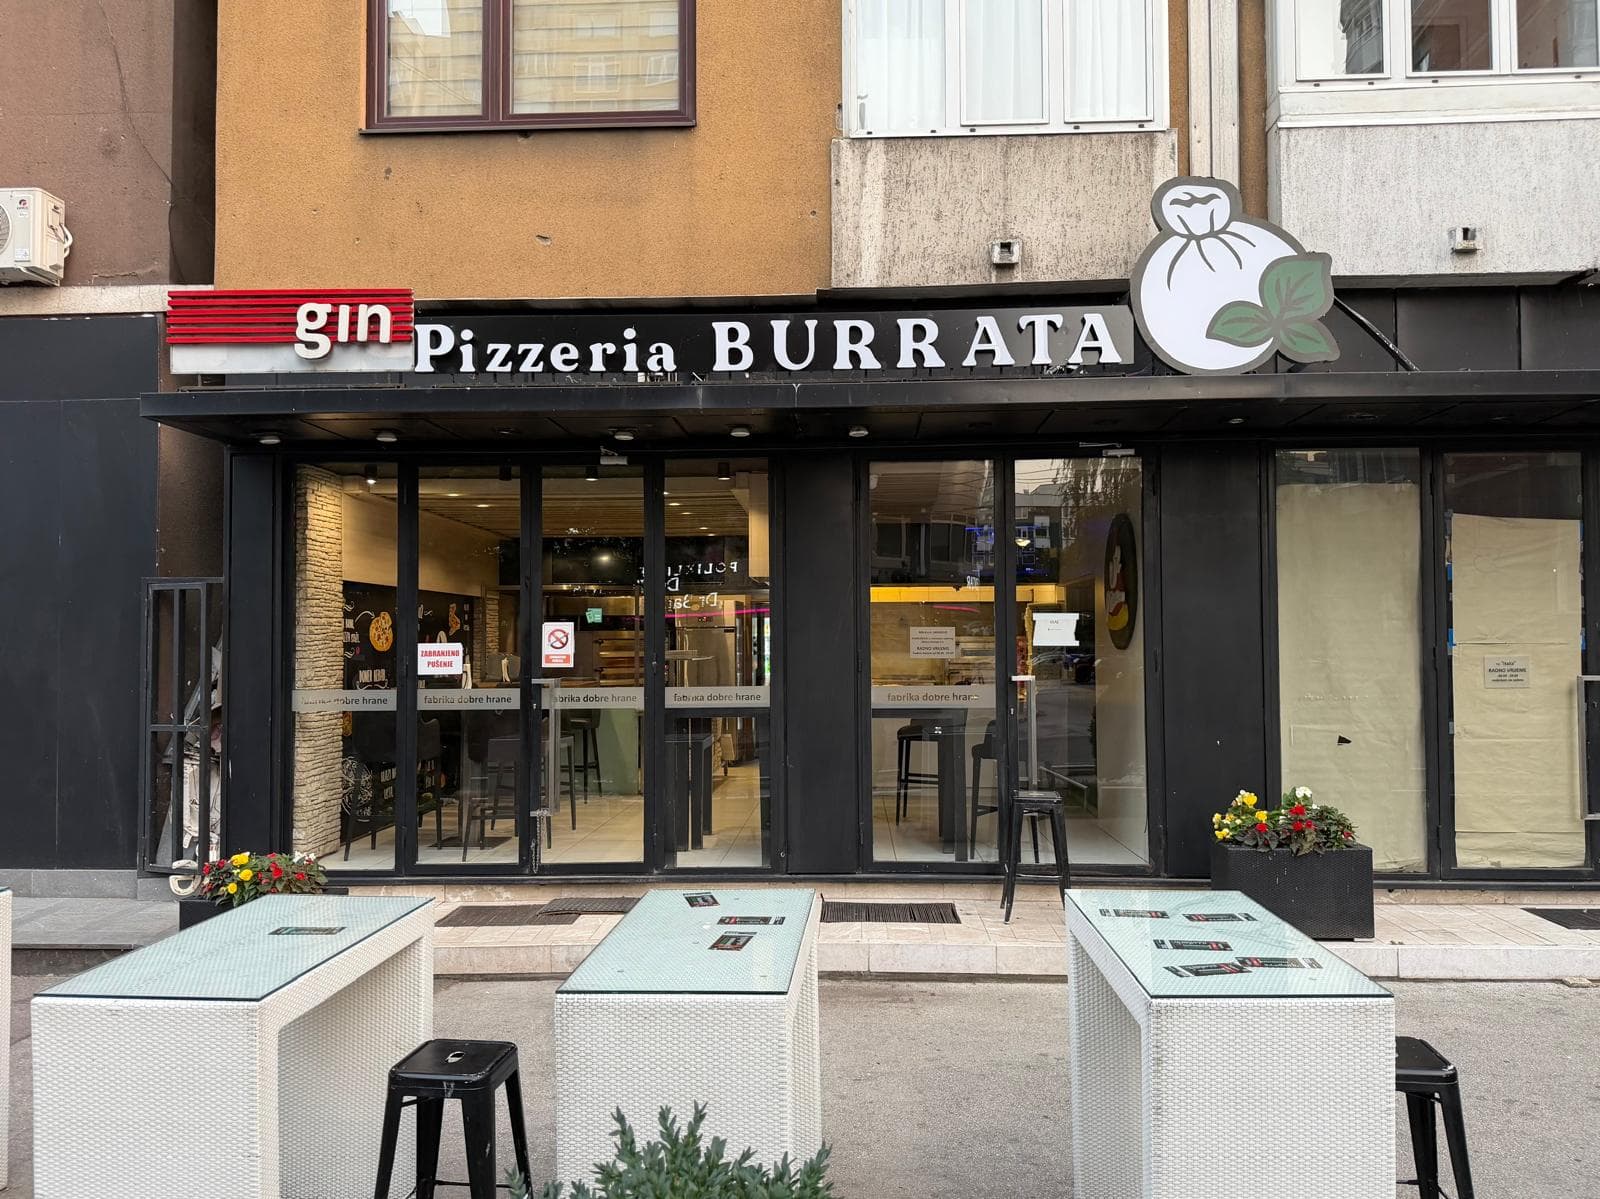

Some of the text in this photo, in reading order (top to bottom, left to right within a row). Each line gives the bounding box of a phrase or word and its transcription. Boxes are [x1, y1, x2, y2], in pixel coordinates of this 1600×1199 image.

[294, 302, 391, 359] gin
[414, 313, 1122, 373] Pizzeria BURRATA
[362, 696, 388, 705] hrane
[424, 694, 512, 704] fabrika dobre hrane
[551, 694, 637, 703] abrika dobre hrane
[707, 693, 734, 702] dobre
[736, 692, 761, 702] hrane
[922, 692, 950, 702] dobre
